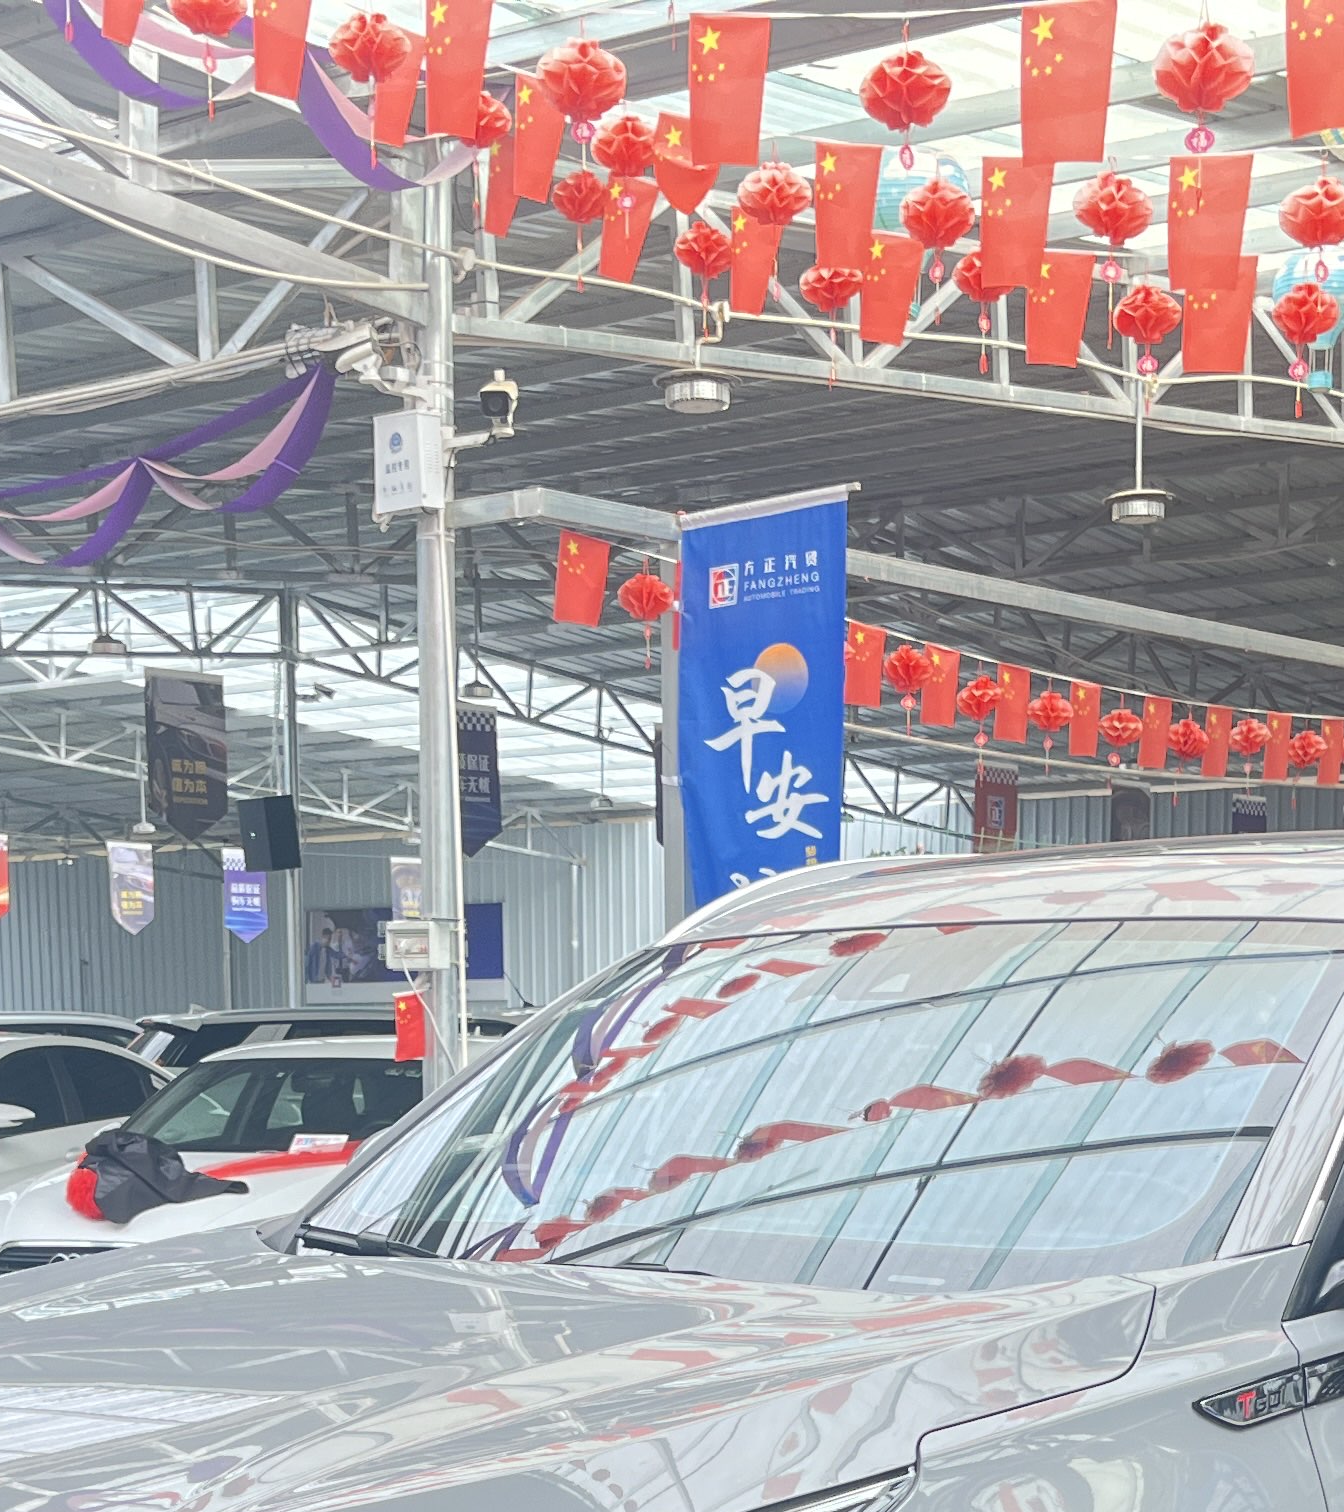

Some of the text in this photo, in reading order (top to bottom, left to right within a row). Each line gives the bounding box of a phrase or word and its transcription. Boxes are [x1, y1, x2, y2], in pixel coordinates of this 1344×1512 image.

[744, 550, 818, 577] 方正汽贸
[743, 572, 820, 592] FANGZHENG
[743, 585, 821, 602] AUTOMOBILE TRADING
[704, 668, 830, 888] 早安
